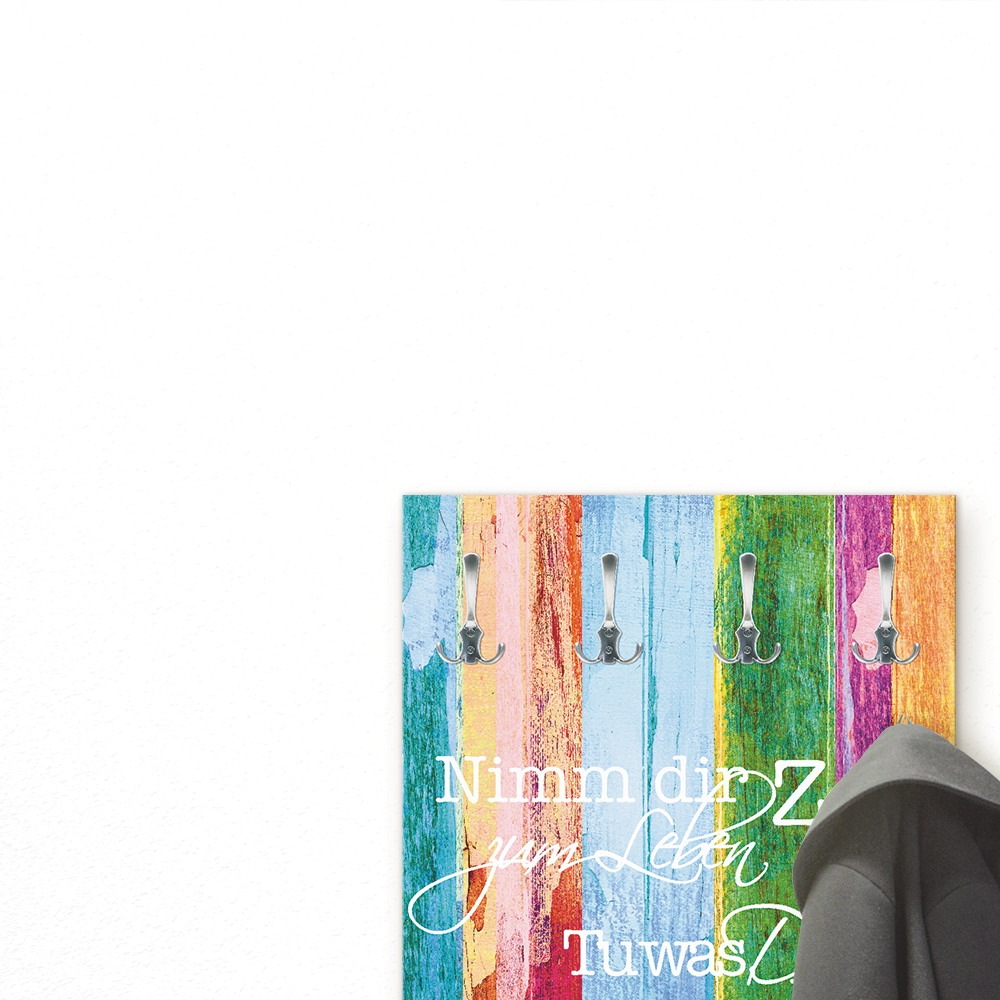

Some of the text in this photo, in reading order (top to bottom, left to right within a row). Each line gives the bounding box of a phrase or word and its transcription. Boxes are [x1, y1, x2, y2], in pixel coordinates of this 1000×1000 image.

[435, 755, 636, 803] Nimm
[655, 756, 748, 803] dir
[407, 771, 776, 935] zum Leben
[563, 929, 634, 977] Tu
[638, 940, 746, 977] was
